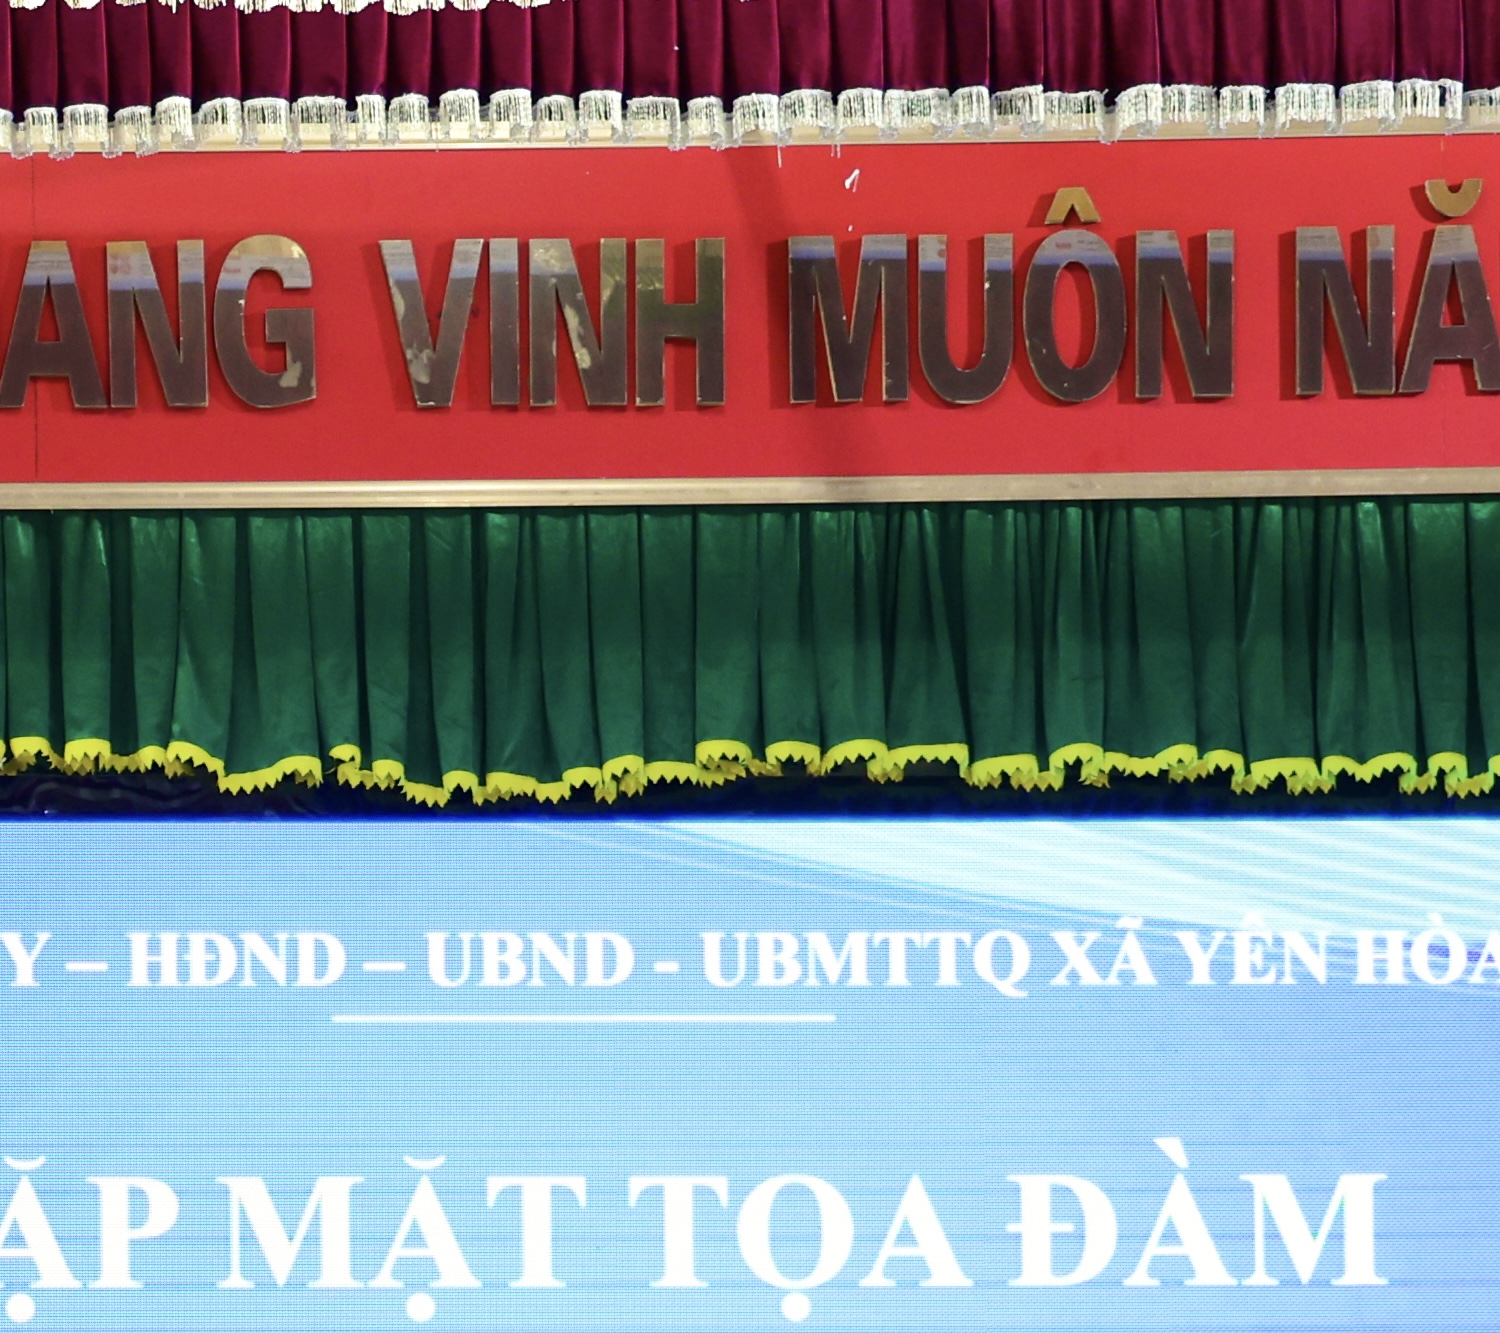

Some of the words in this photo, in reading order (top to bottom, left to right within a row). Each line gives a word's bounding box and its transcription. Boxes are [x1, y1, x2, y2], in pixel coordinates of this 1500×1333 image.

[376, 237, 728, 409] VINH
[787, 185, 1236, 407] MUÔN
[125, 929, 347, 989] HĐND
[424, 929, 635, 989] UBND
[701, 929, 1032, 998] UBMTTQ
[1049, 915, 1159, 988] XÃ
[1172, 913, 1331, 988] YÊN
[214, 1155, 587, 1324] MẶT
[627, 1172, 974, 1323] TỌA
[1003, 1136, 1389, 1288] ĐÀM
